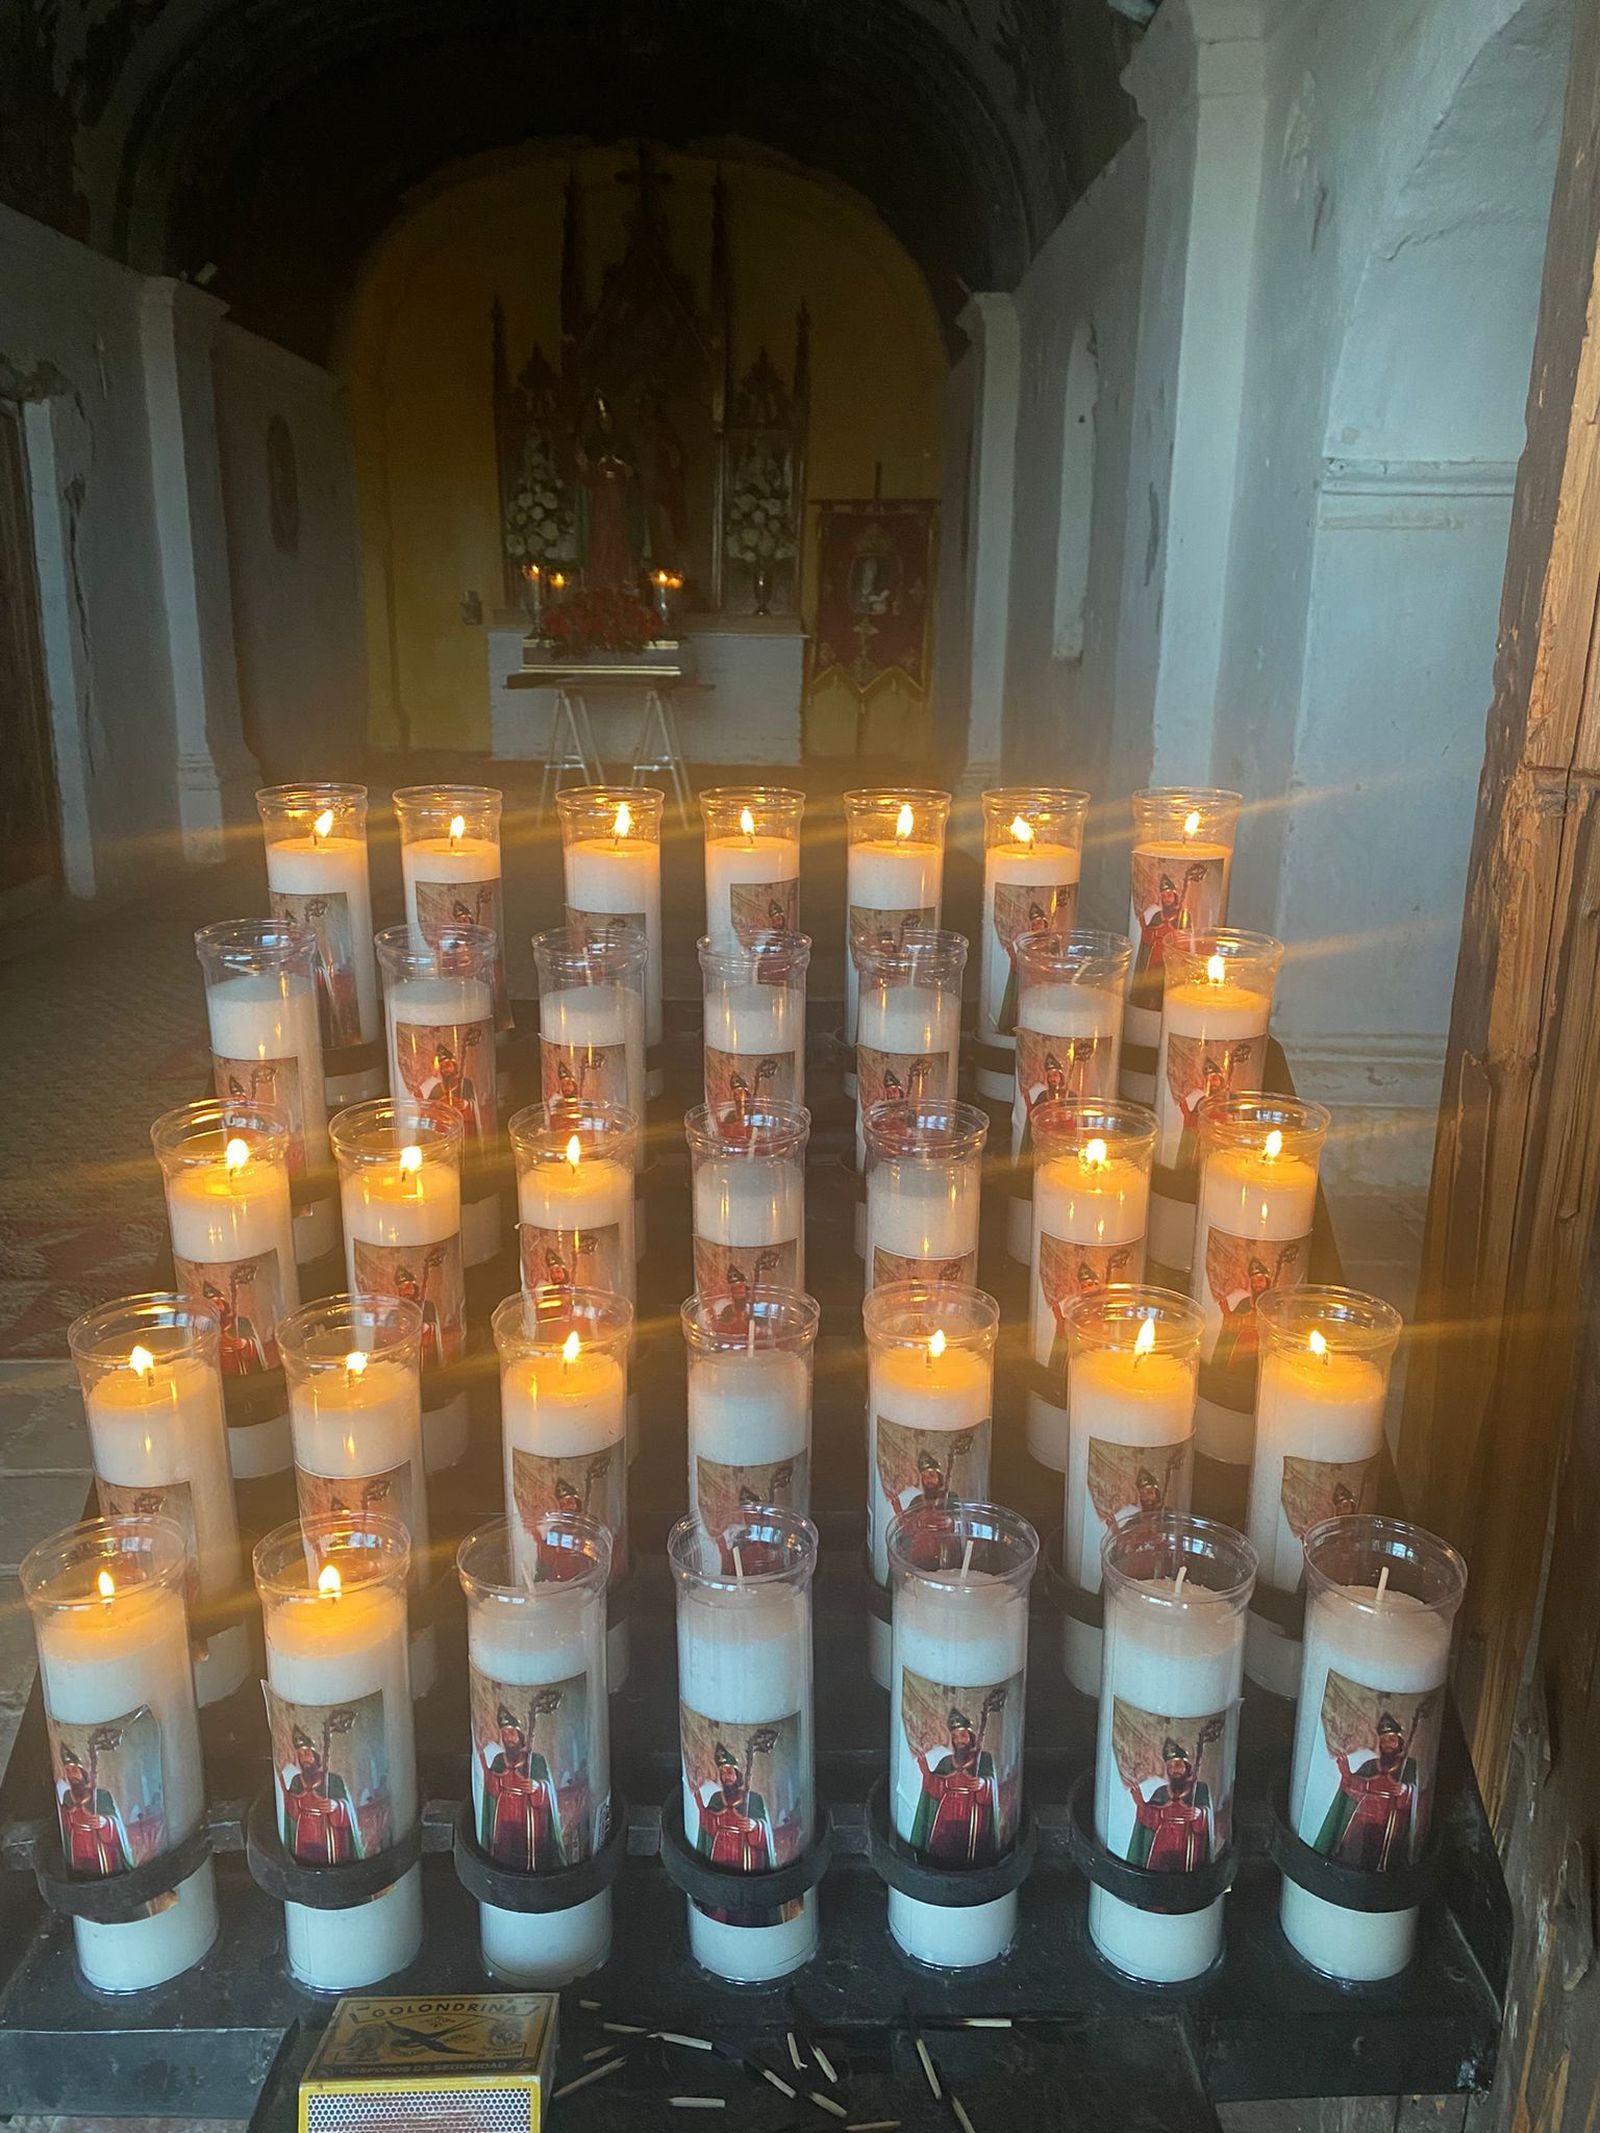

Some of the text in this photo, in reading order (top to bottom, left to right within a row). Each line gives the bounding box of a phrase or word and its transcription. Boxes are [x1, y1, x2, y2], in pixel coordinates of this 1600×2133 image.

[372, 2003, 517, 2018] GOLONDRINA
[342, 2061, 508, 2074] FOSFOROS DE SEGURIDAD
